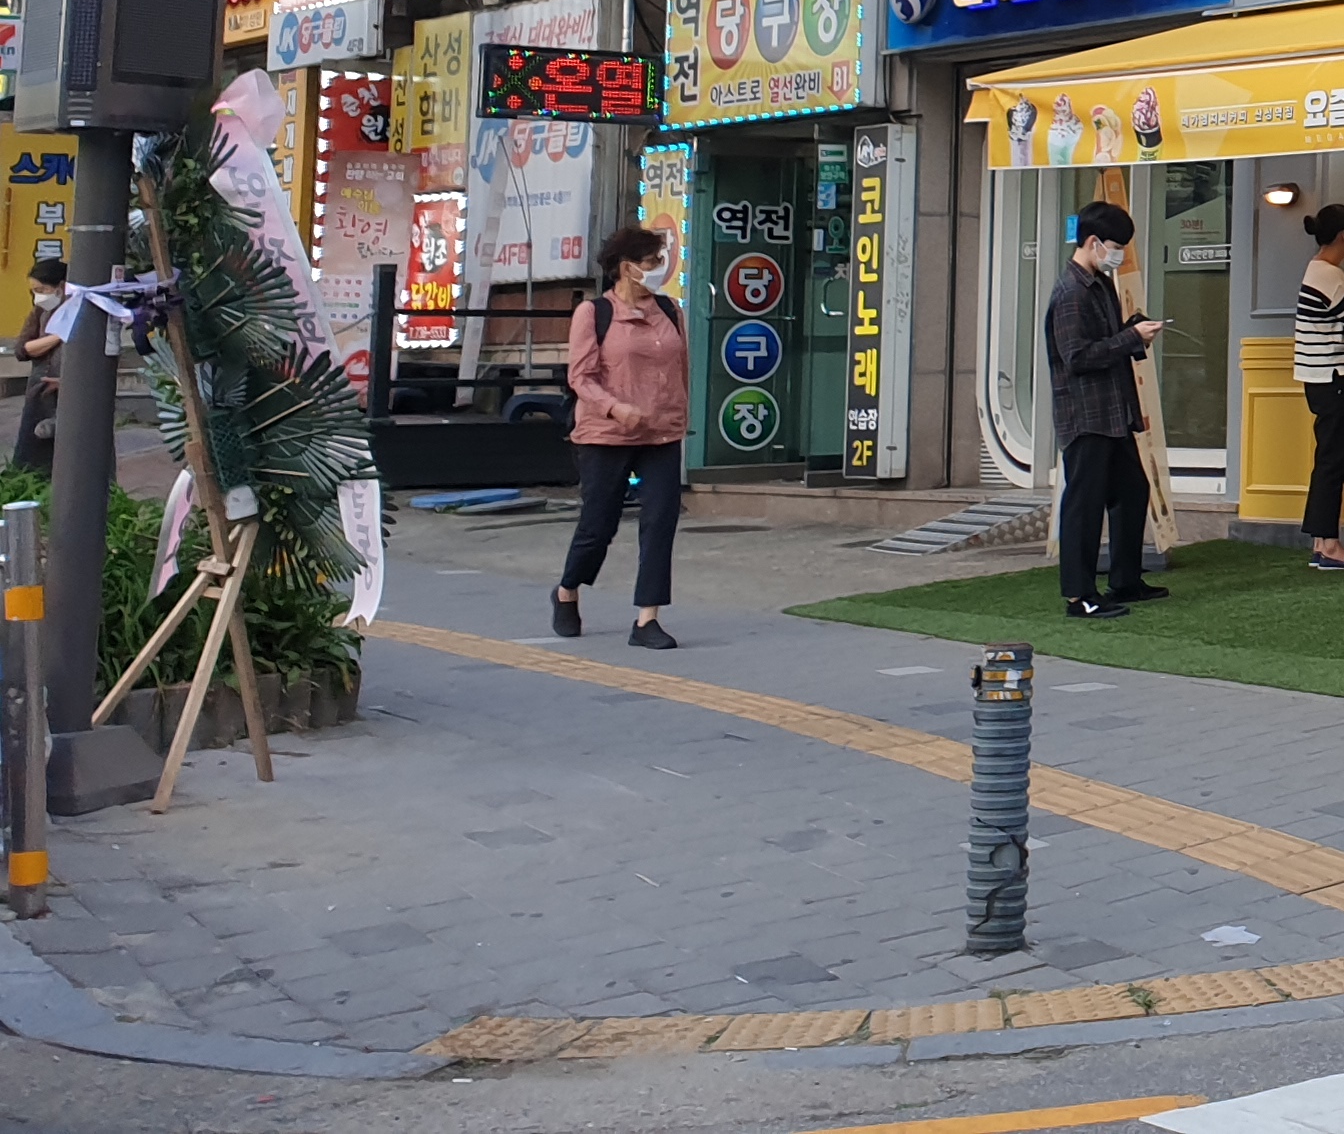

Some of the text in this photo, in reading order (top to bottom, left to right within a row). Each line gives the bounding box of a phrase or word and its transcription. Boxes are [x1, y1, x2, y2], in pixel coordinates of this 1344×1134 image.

[710, 70, 822, 106] 아스트로 열선완비
[645, 157, 686, 199] 역전
[713, 200, 793, 244] 역전
[854, 177, 883, 398] 코인노래
[733, 267, 774, 440] 당구장
[848, 407, 879, 432] 연습장
[852, 439, 873, 468] 2F
